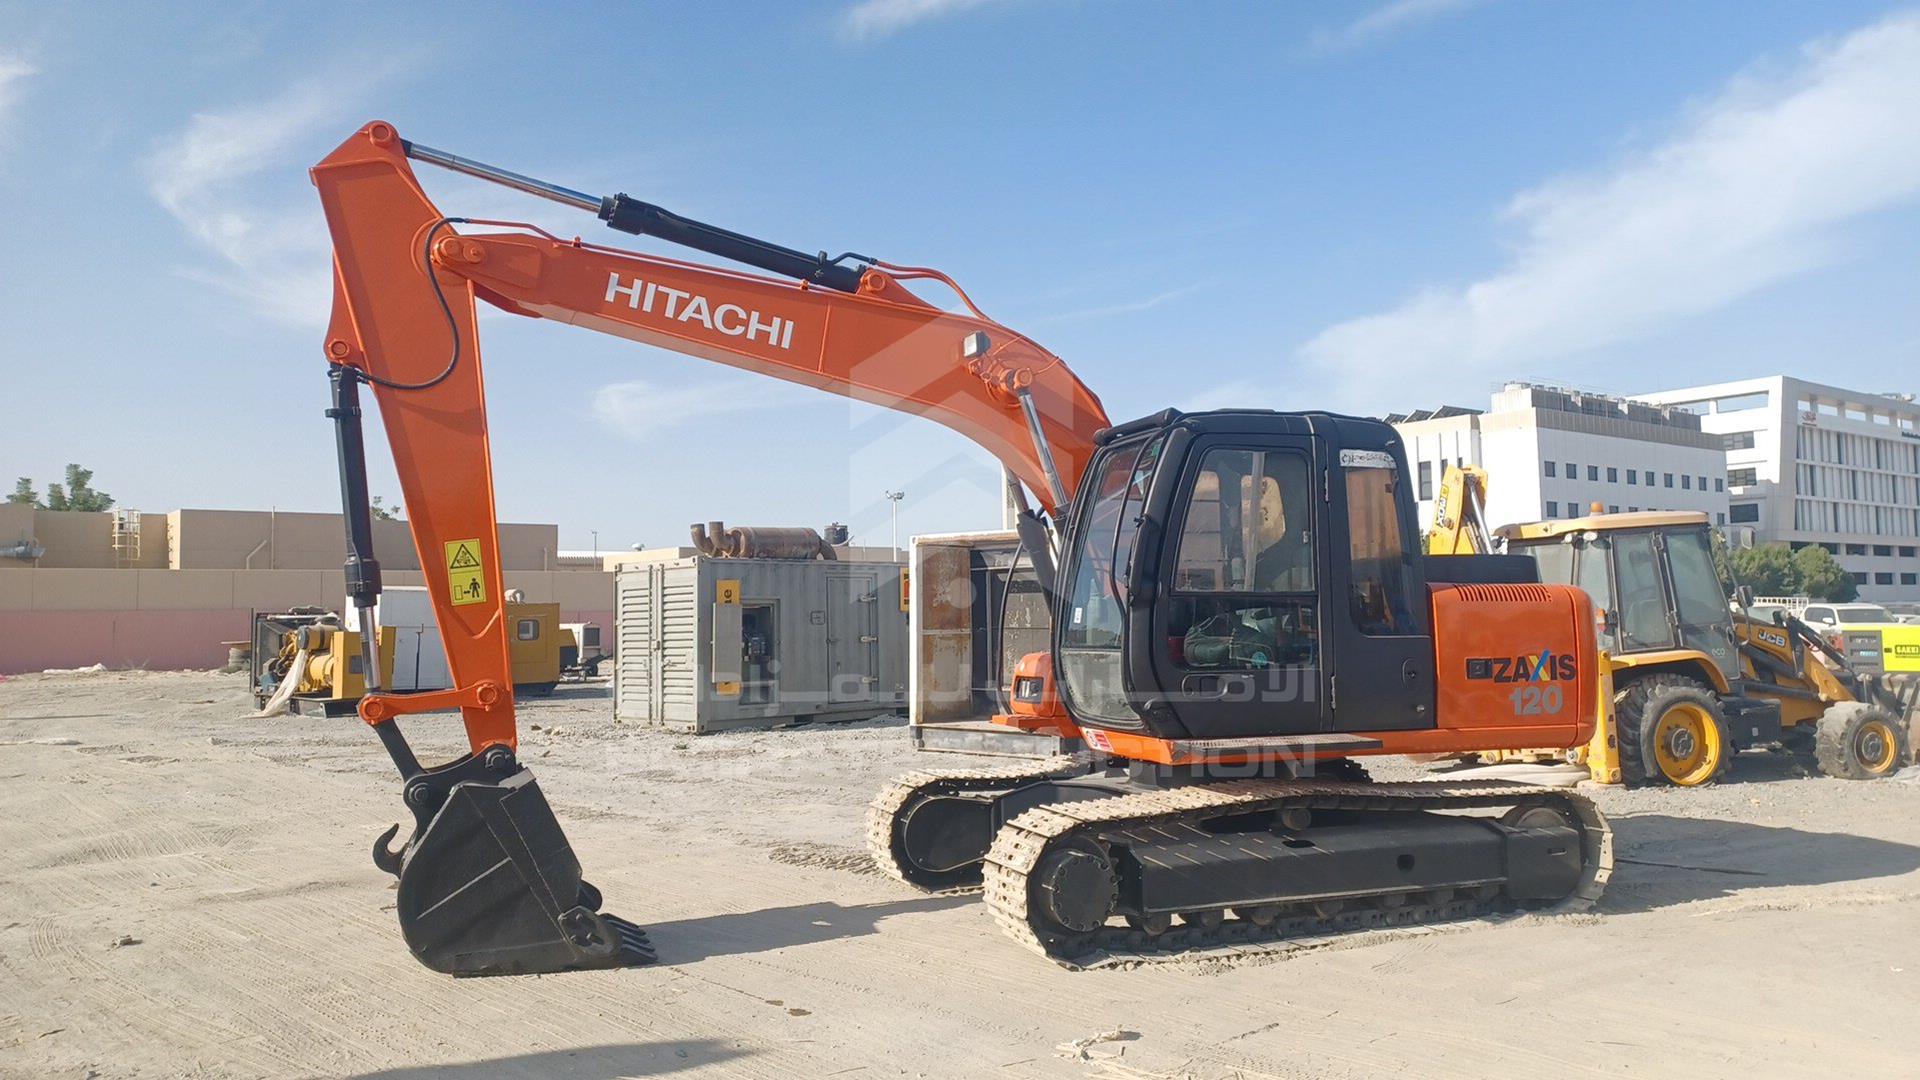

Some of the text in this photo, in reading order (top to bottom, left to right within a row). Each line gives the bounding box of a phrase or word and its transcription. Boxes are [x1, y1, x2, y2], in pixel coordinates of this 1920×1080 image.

[604, 271, 794, 350] HITACHI
[1758, 630, 1786, 647] JCB
[1493, 650, 1576, 683] ZAXIS
[1509, 685, 1563, 715] 120
